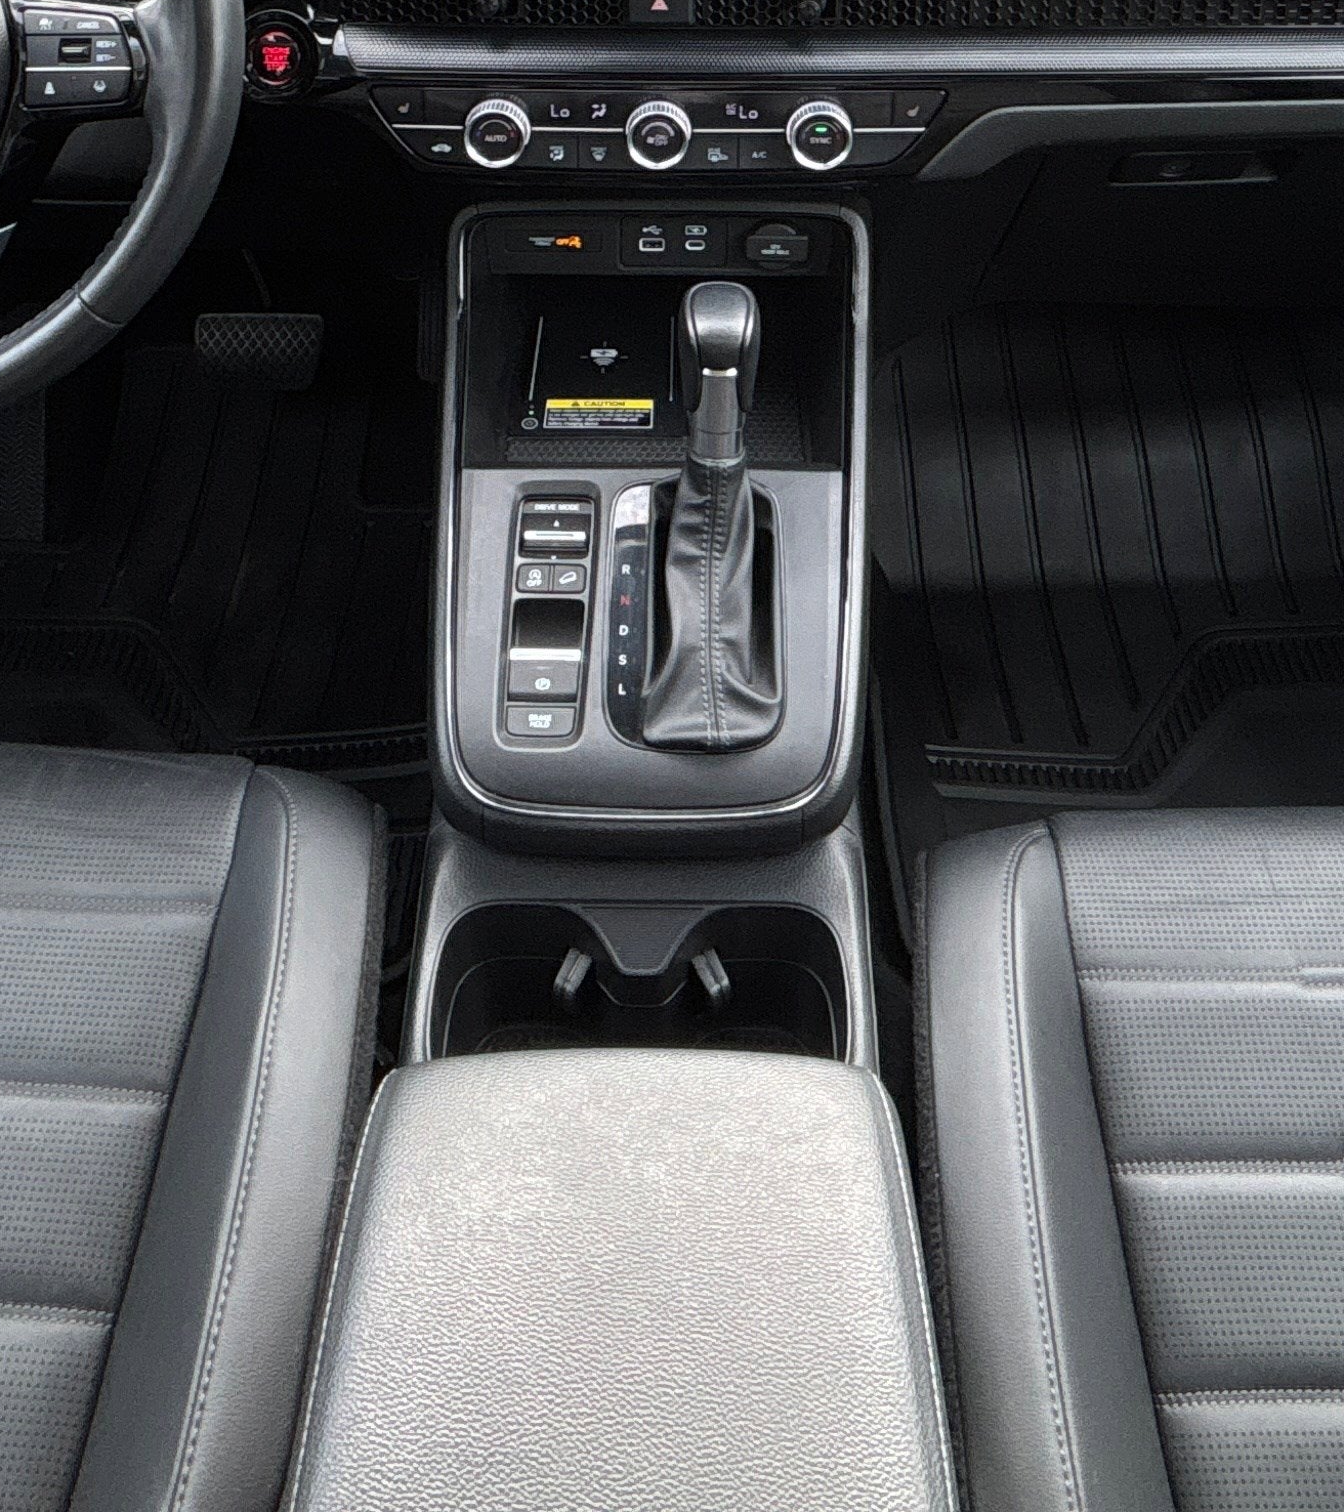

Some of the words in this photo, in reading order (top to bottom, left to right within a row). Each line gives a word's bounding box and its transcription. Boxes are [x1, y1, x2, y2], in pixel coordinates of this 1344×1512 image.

[549, 103, 571, 119] Lo
[738, 104, 759, 120] Lo
[483, 134, 508, 143] AUTO
[809, 137, 833, 145] SYNC
[583, 400, 626, 408] CAUTION
[533, 503, 557, 511] DRIVE
[558, 503, 580, 511] MODE
[621, 564, 632, 576] R
[619, 595, 632, 606] N
[618, 624, 630, 637] D
[618, 654, 628, 666] S
[618, 684, 627, 696] L
